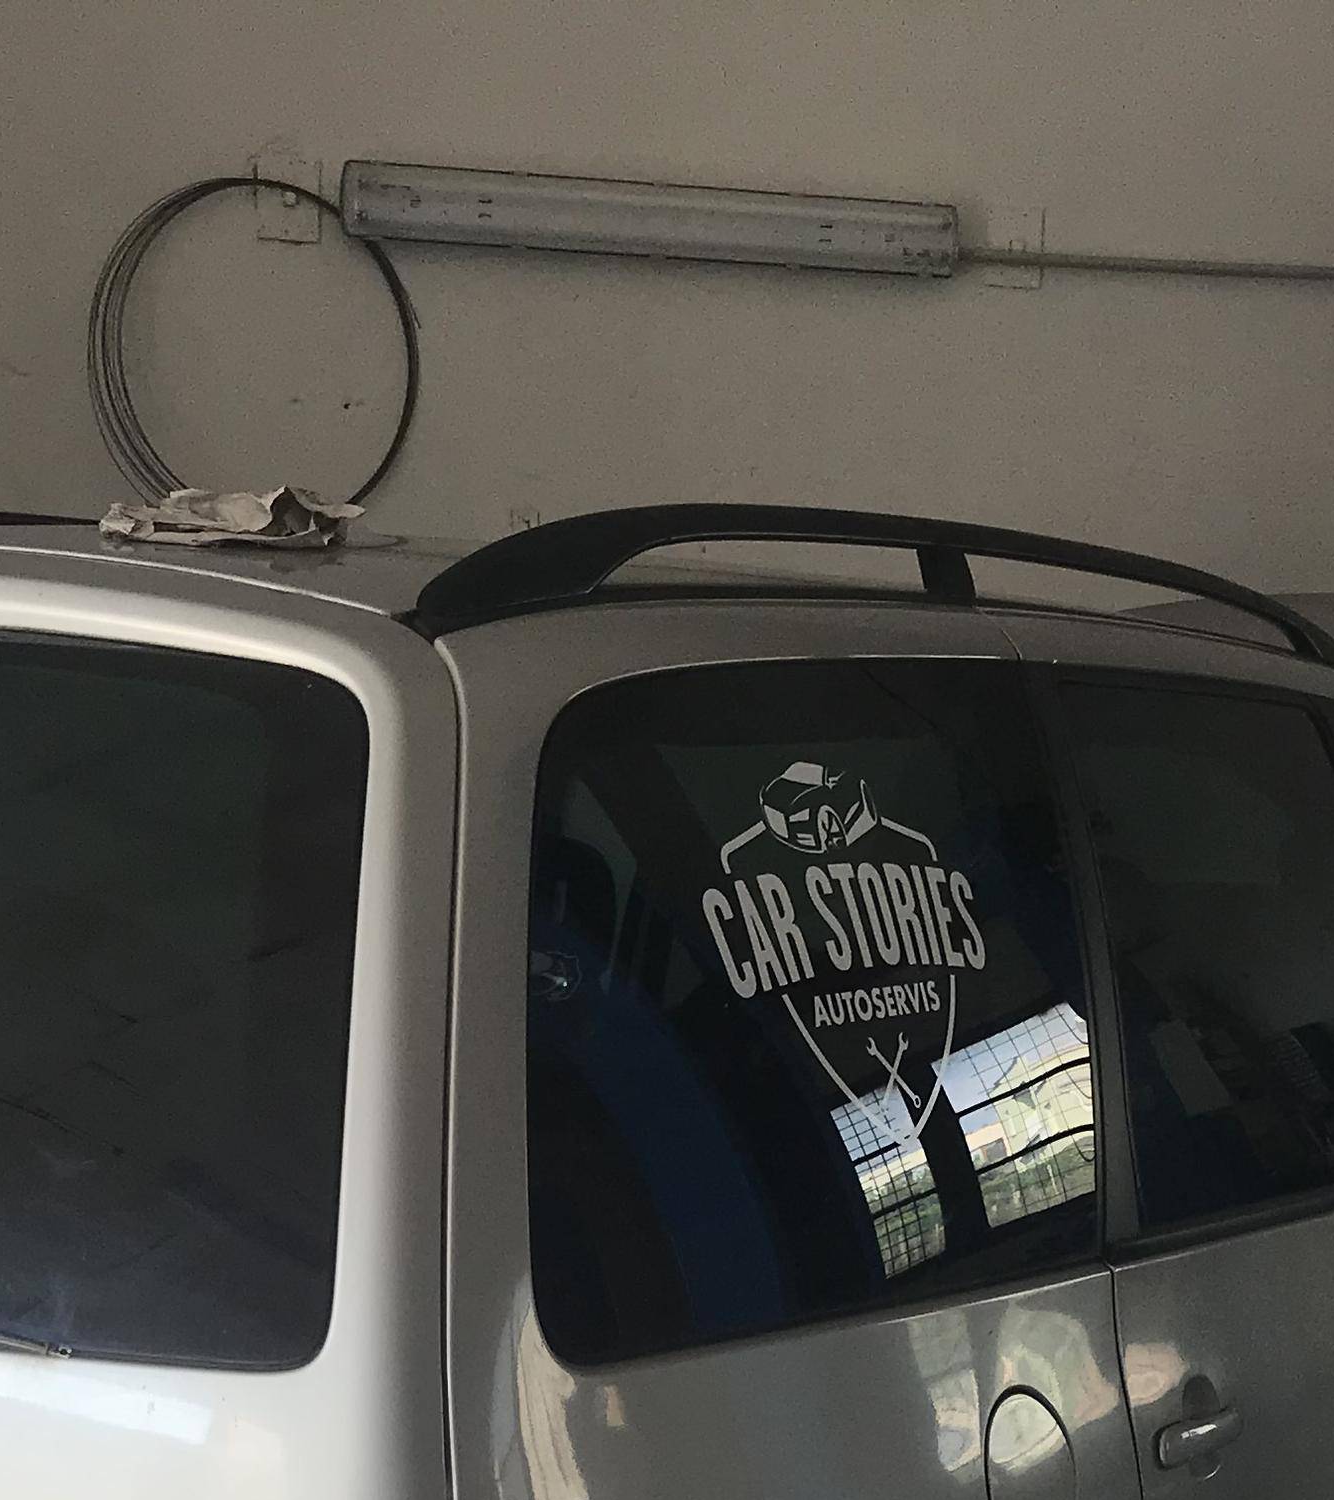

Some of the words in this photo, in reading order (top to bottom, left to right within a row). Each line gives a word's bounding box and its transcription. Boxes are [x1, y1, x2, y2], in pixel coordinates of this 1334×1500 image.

[701, 873, 816, 999] CAR
[804, 861, 987, 971] STORIES
[813, 979, 942, 1028] AUTOSERVIS
